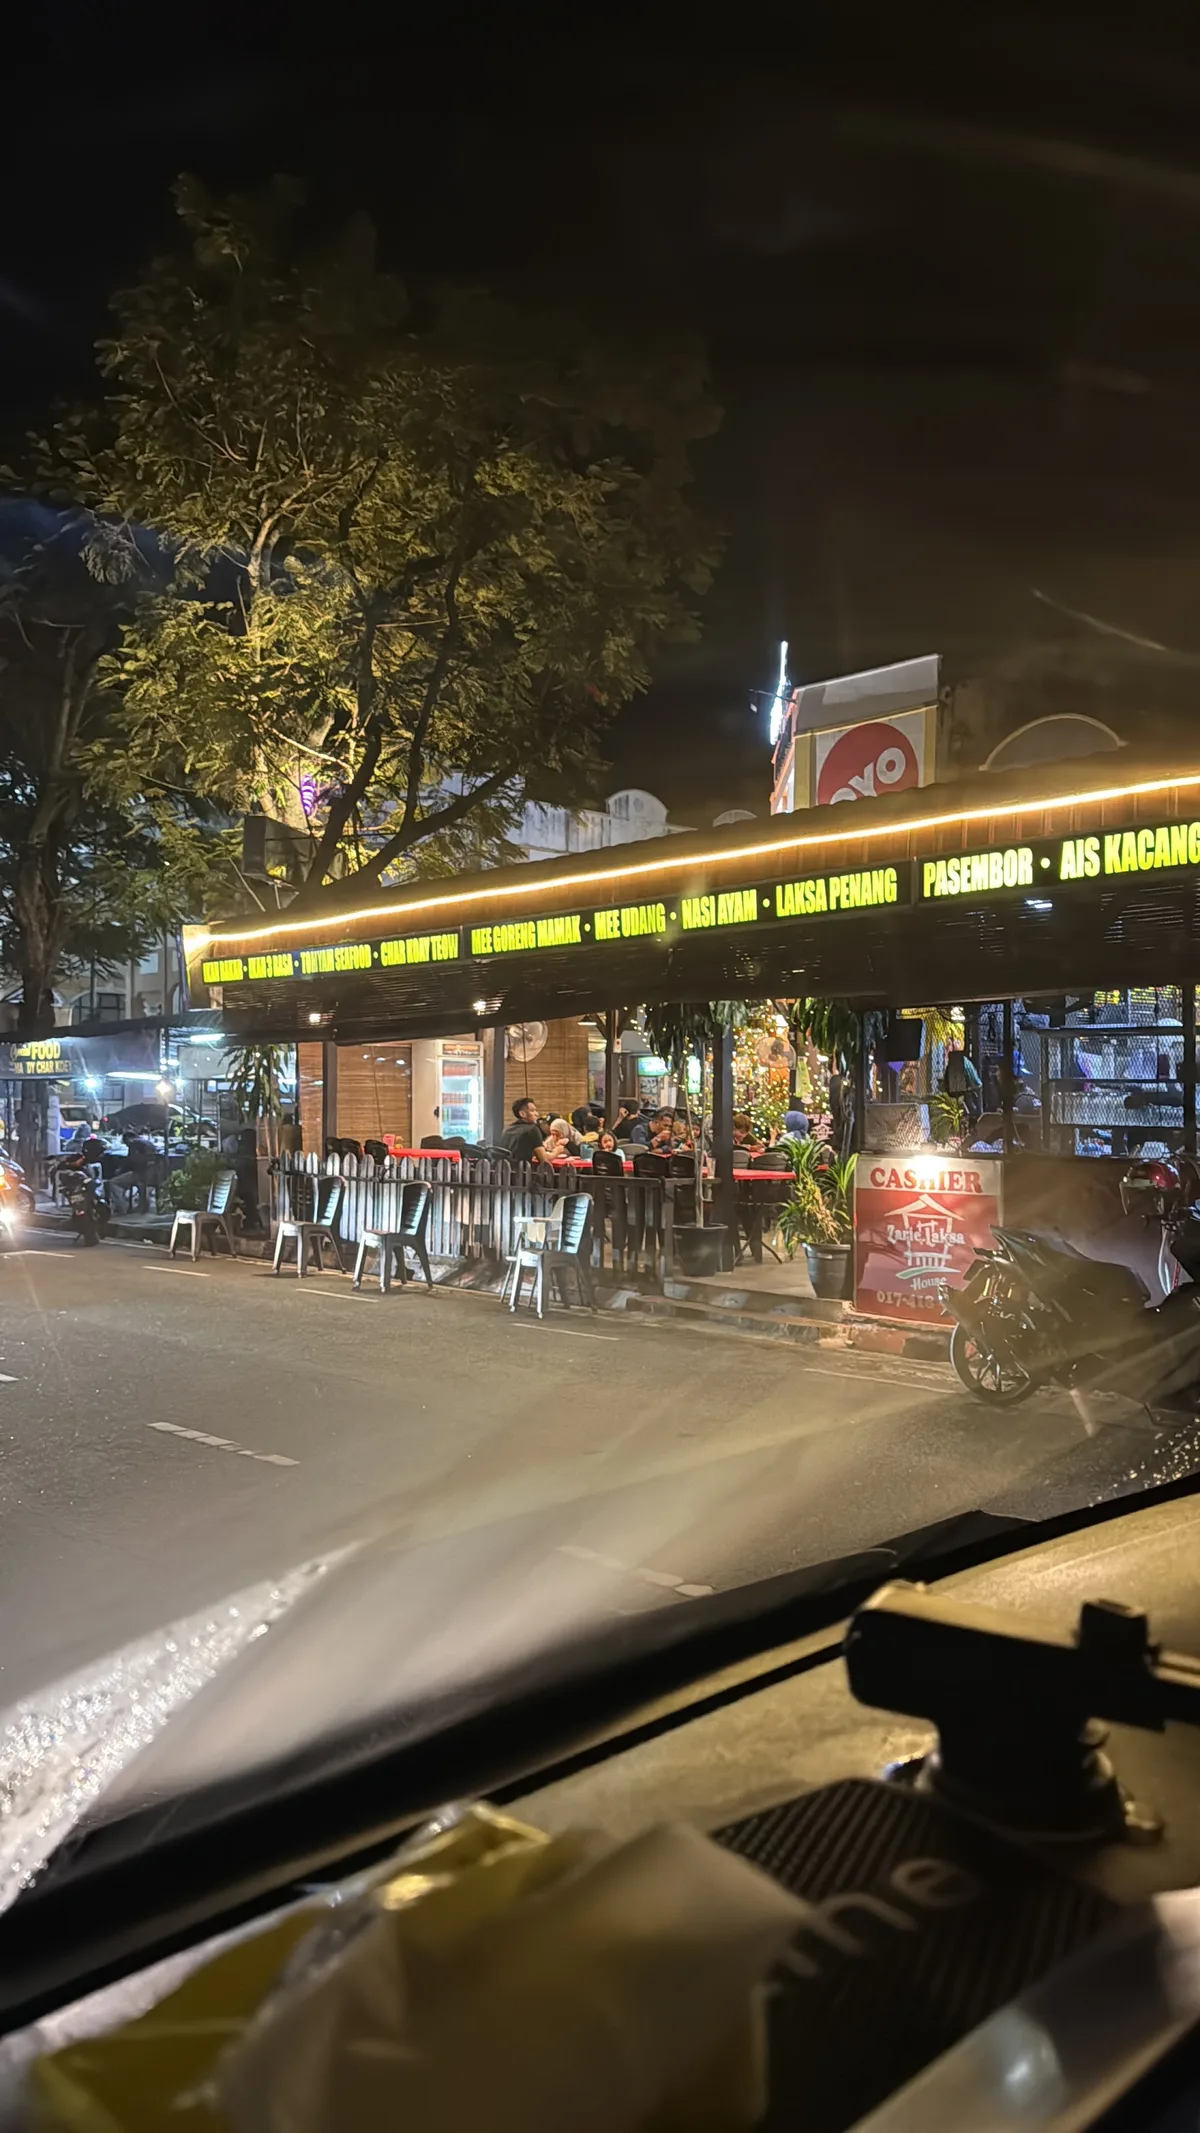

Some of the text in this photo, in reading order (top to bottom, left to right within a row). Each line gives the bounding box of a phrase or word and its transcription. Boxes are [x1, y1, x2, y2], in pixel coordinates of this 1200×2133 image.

[923, 821, 1200, 898] PASEMBOR AIS KACANG
[471, 867, 898, 955] MEE GORENG MAMAK MEE UDANG NASI AYAM LAKSA PENANG
[334, 944, 372, 972] SEAFOOD
[380, 940, 406, 967] CHAR
[406, 937, 431, 964] KOAY
[431, 933, 459, 961] TEOW
[31, 1041, 61, 1060] FOOD
